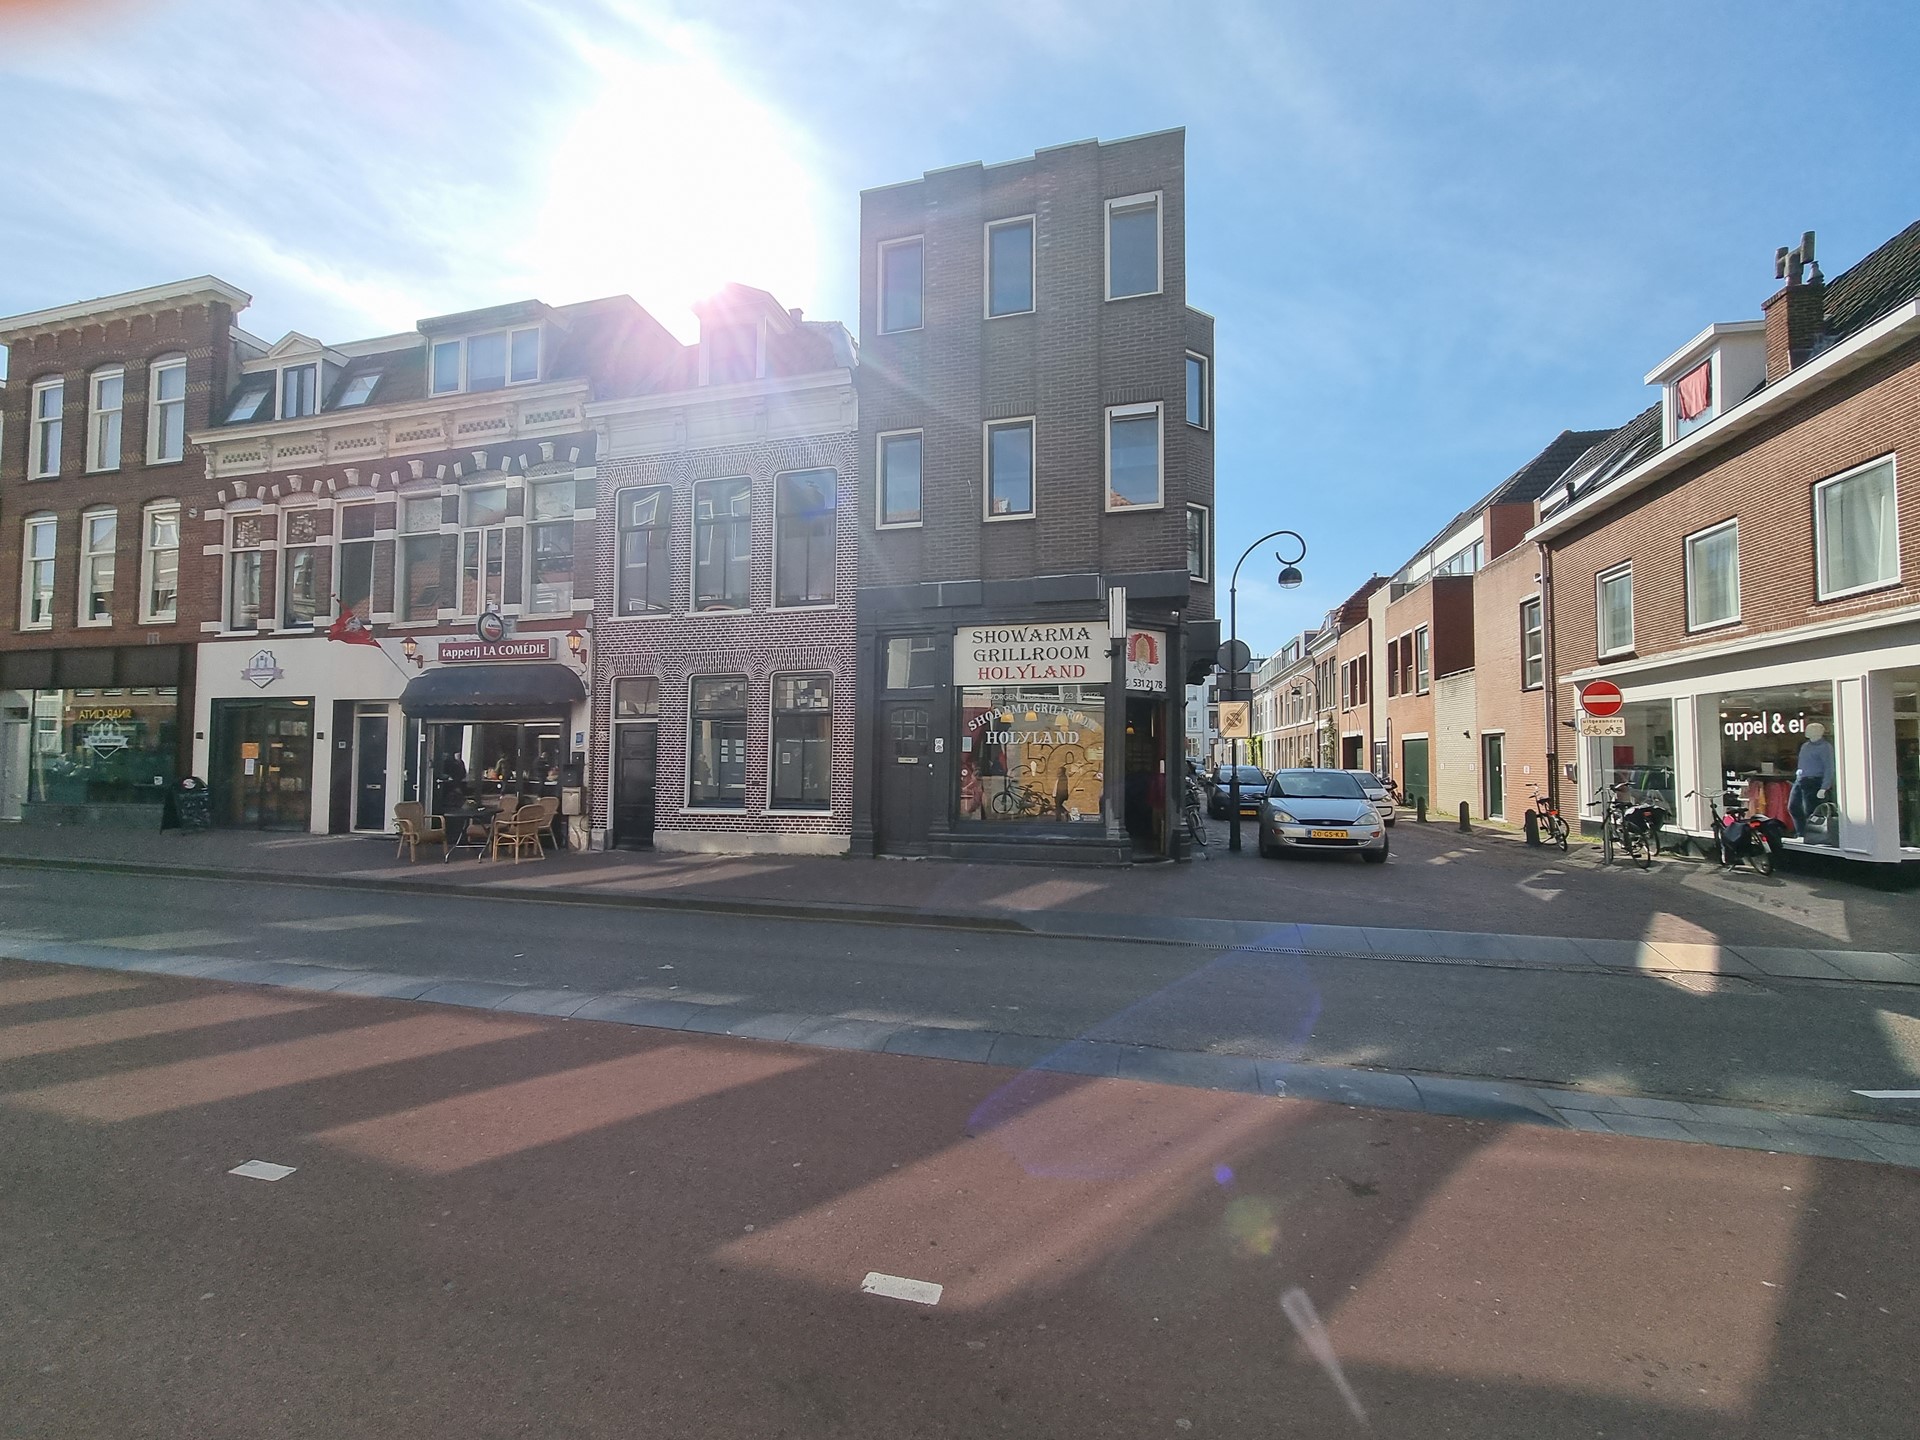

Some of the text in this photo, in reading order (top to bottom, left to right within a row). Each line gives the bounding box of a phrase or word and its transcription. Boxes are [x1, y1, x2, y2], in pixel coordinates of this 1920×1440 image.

[972, 627, 1092, 644] SHOWARMA
[442, 642, 546, 659] tapperij LA COMÉDIE
[974, 645, 1090, 662] GRILLROOM
[978, 663, 1085, 681] HOLYLAND
[1725, 711, 1805, 741] appel & ei
[986, 731, 1079, 745] HOLYLAND
